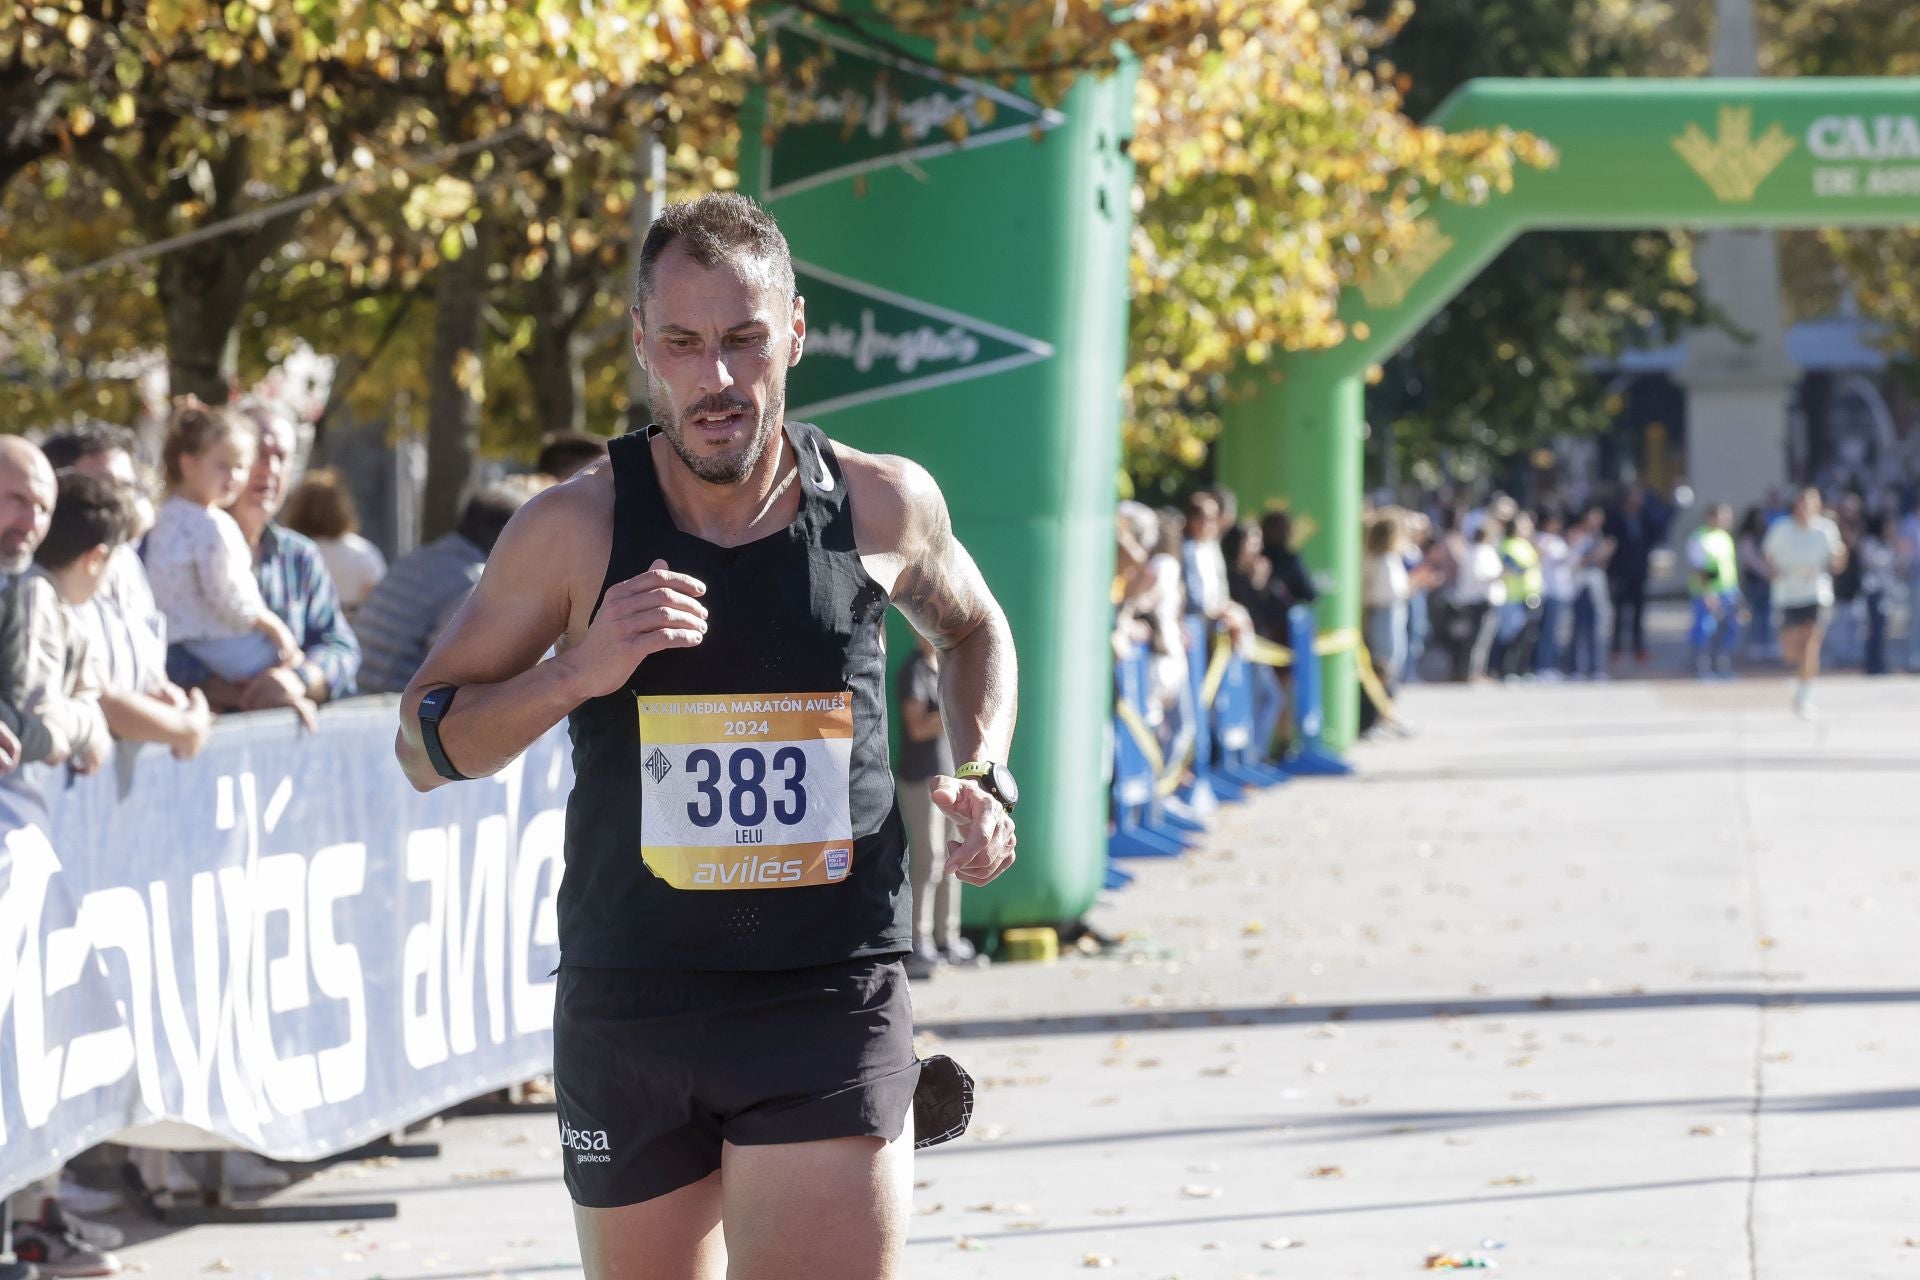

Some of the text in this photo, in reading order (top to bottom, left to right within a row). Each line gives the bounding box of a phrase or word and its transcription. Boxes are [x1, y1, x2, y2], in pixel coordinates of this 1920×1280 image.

[684, 701, 728, 715] MEDIA
[731, 695, 802, 714] MARATÓN
[805, 694, 846, 712] AVILÉS
[724, 720, 769, 736] 2024
[685, 746, 807, 827] 383
[735, 829, 763, 843] LELU
[692, 855, 803, 884] avilés
[577, 1153, 611, 1164] gasóleos
